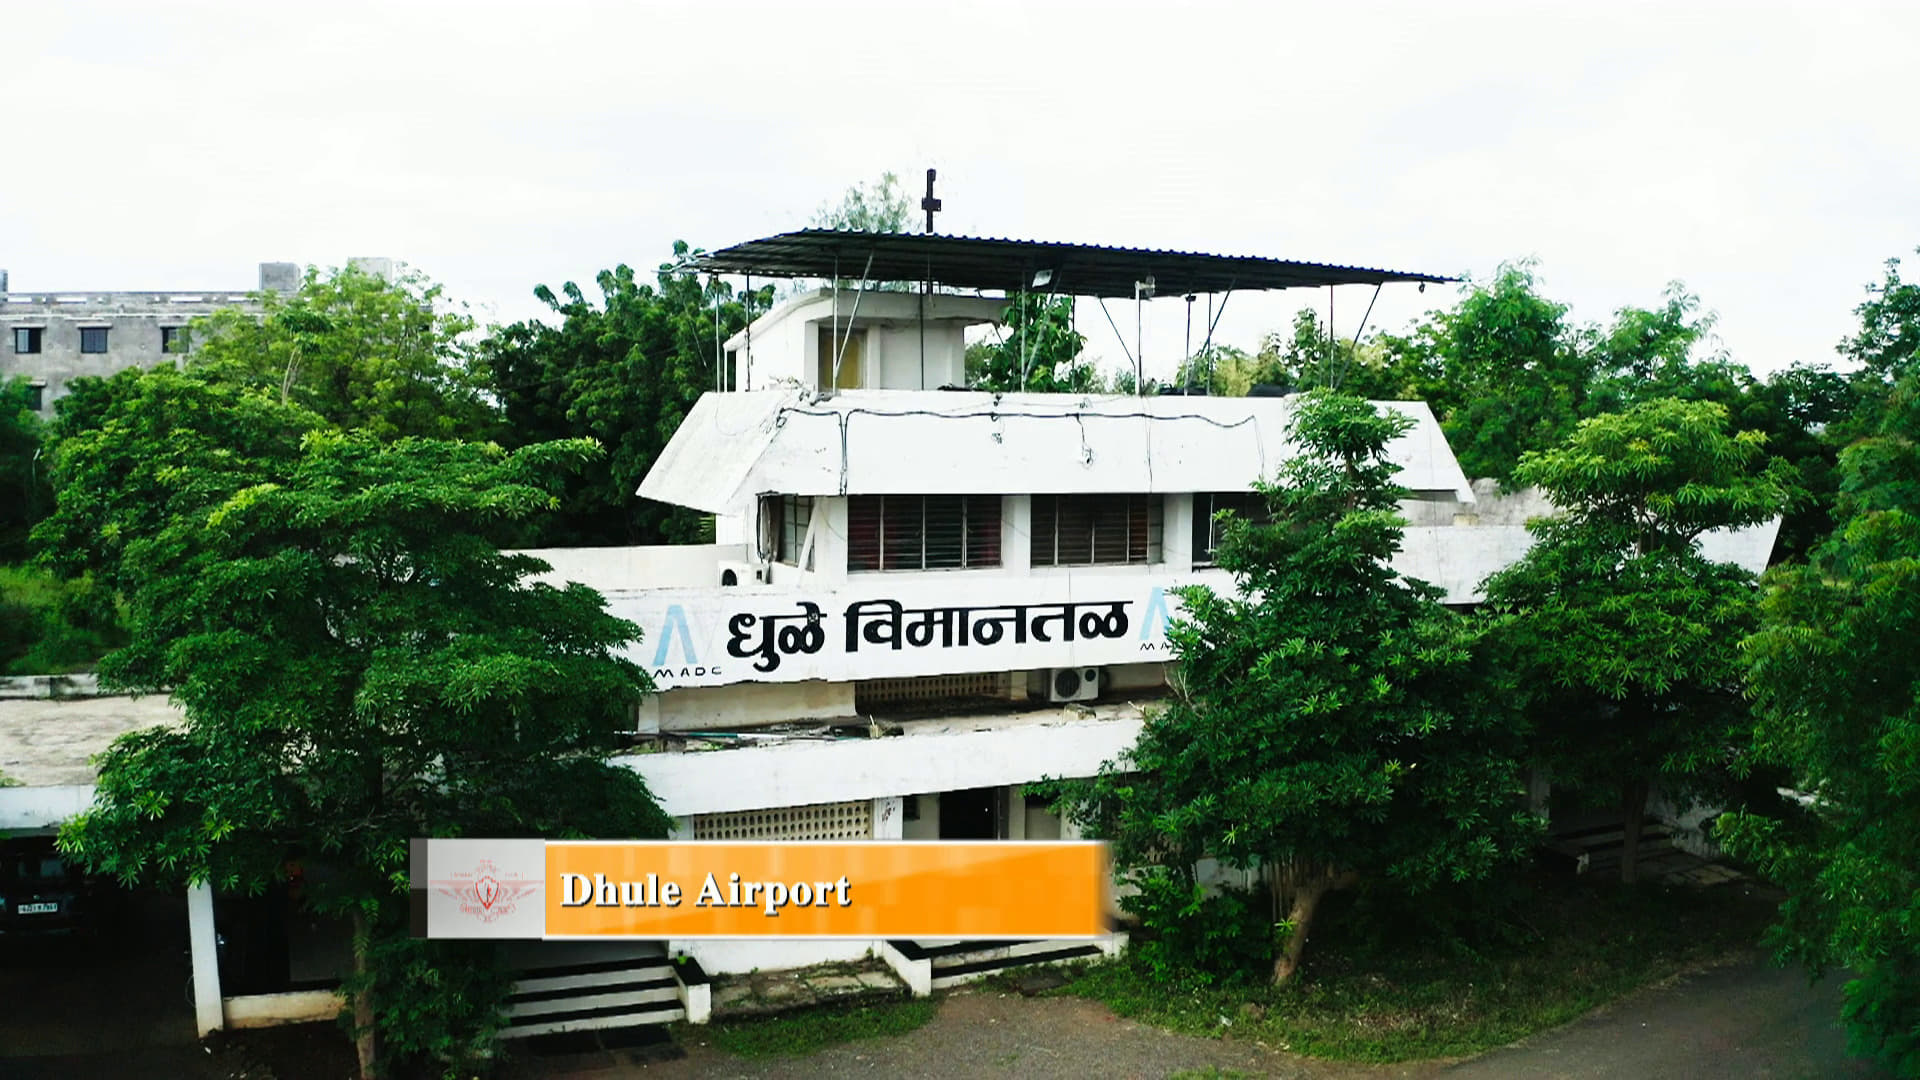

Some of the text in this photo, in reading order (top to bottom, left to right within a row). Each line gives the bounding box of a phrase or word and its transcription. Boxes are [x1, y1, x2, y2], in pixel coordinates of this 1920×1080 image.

[726, 599, 1133, 673] धुळे विमानतळ
[654, 666, 722, 678] MADC
